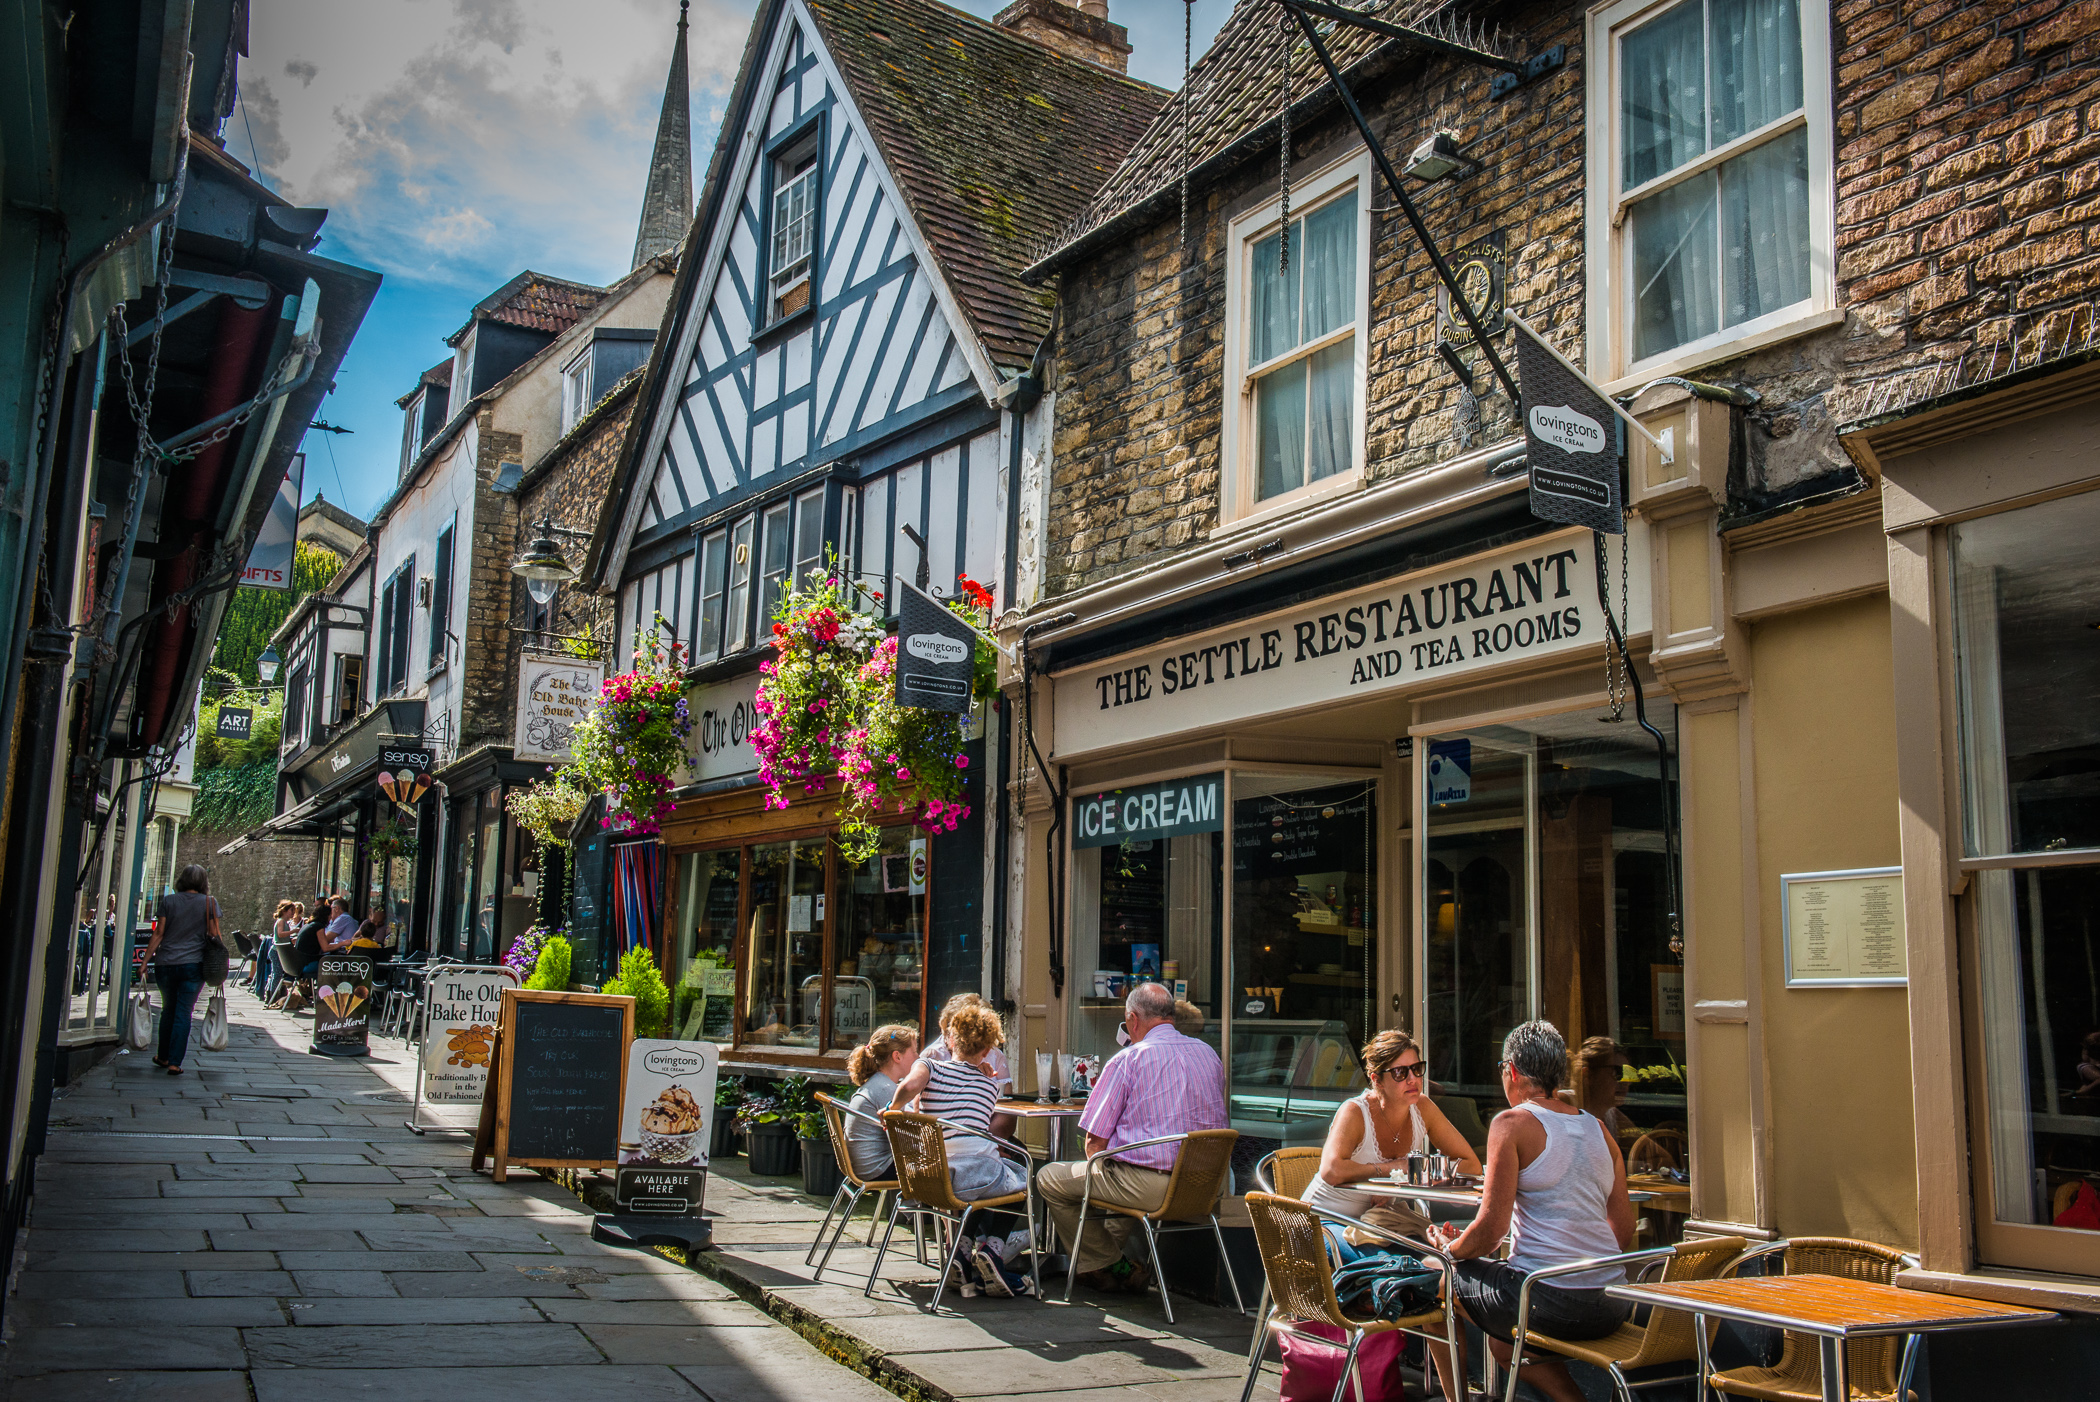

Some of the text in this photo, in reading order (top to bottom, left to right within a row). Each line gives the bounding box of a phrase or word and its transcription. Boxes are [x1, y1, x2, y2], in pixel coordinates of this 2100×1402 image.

[1536, 410, 1598, 440] lovingtons
[1552, 435, 1584, 448] ICE CREAM
[1537, 476, 1604, 498] WWW.LOVINGTONS.CO.UK
[1096, 548, 1578, 710] THE SETTLE RESTAURANT
[912, 638, 962, 654] lovingtons
[1350, 606, 1581, 685] AND TEA ROOMS
[550, 678, 570, 691] The
[532, 691, 588, 708] Old Bake
[541, 704, 576, 718] House
[221, 714, 249, 728] ART
[702, 699, 759, 758] The Old
[384, 751, 429, 770] senso
[1434, 786, 1466, 802] LAVAZZA
[1078, 783, 1216, 838] ICE CREAM
[322, 961, 370, 980] senso
[446, 984, 503, 1002] The Old
[432, 1004, 498, 1022] Bake Hou
[318, 1014, 366, 1032] Made Here!
[530, 1022, 548, 1037] THE
[550, 1028, 568, 1038] OLD
[651, 1054, 698, 1066] lovingtons
[428, 1073, 478, 1082] Traditionally
[427, 1092, 482, 1100] Old Fashioned
[634, 1175, 689, 1185] AVAILABLE
[648, 1184, 674, 1194] HERE
